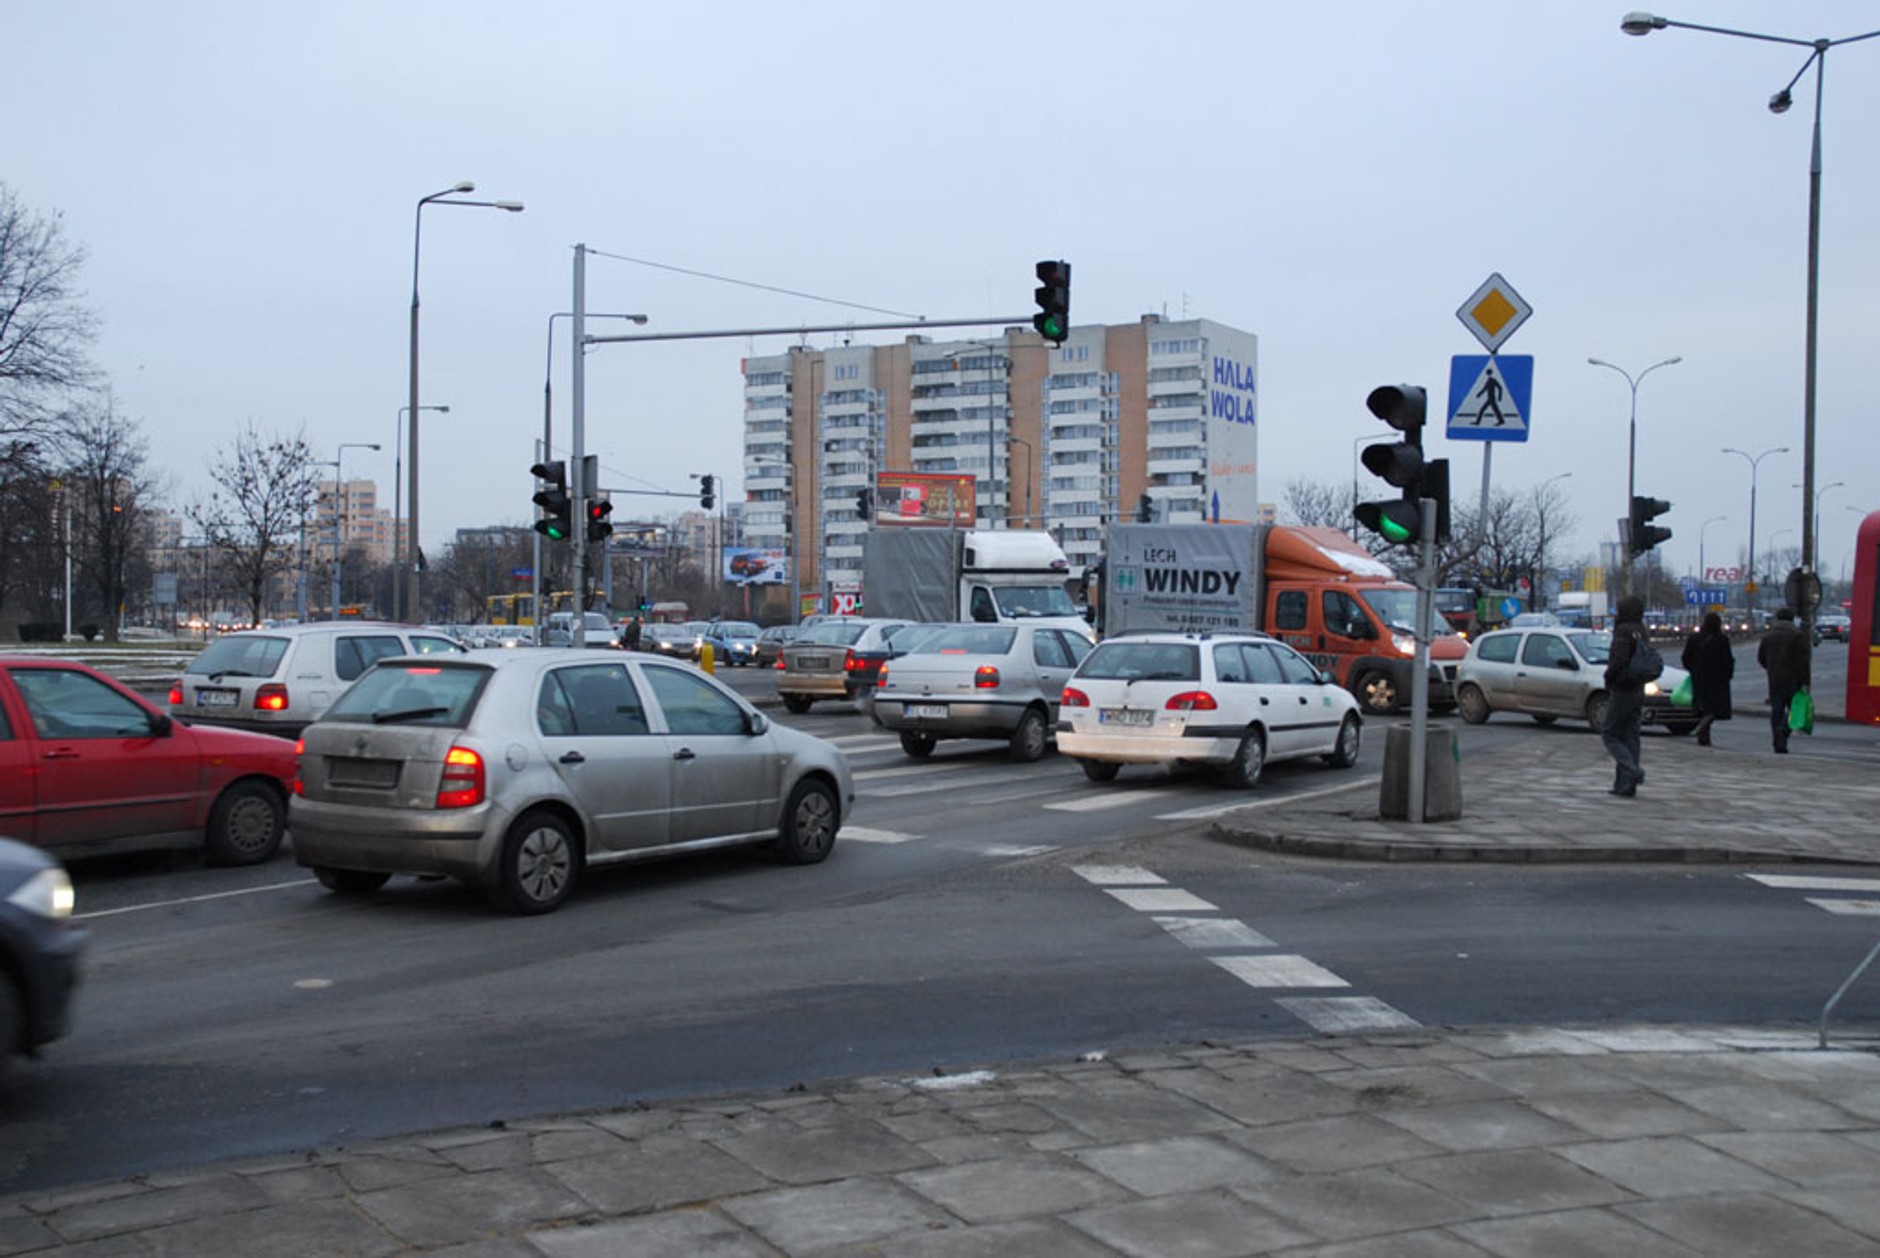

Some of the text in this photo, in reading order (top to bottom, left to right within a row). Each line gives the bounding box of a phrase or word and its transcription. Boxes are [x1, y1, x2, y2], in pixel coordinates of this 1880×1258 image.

[1213, 355, 1255, 394] HALA
[1211, 389, 1255, 426] WOLA
[1143, 548, 1177, 563] LECH
[1144, 568, 1241, 596] WINDY
